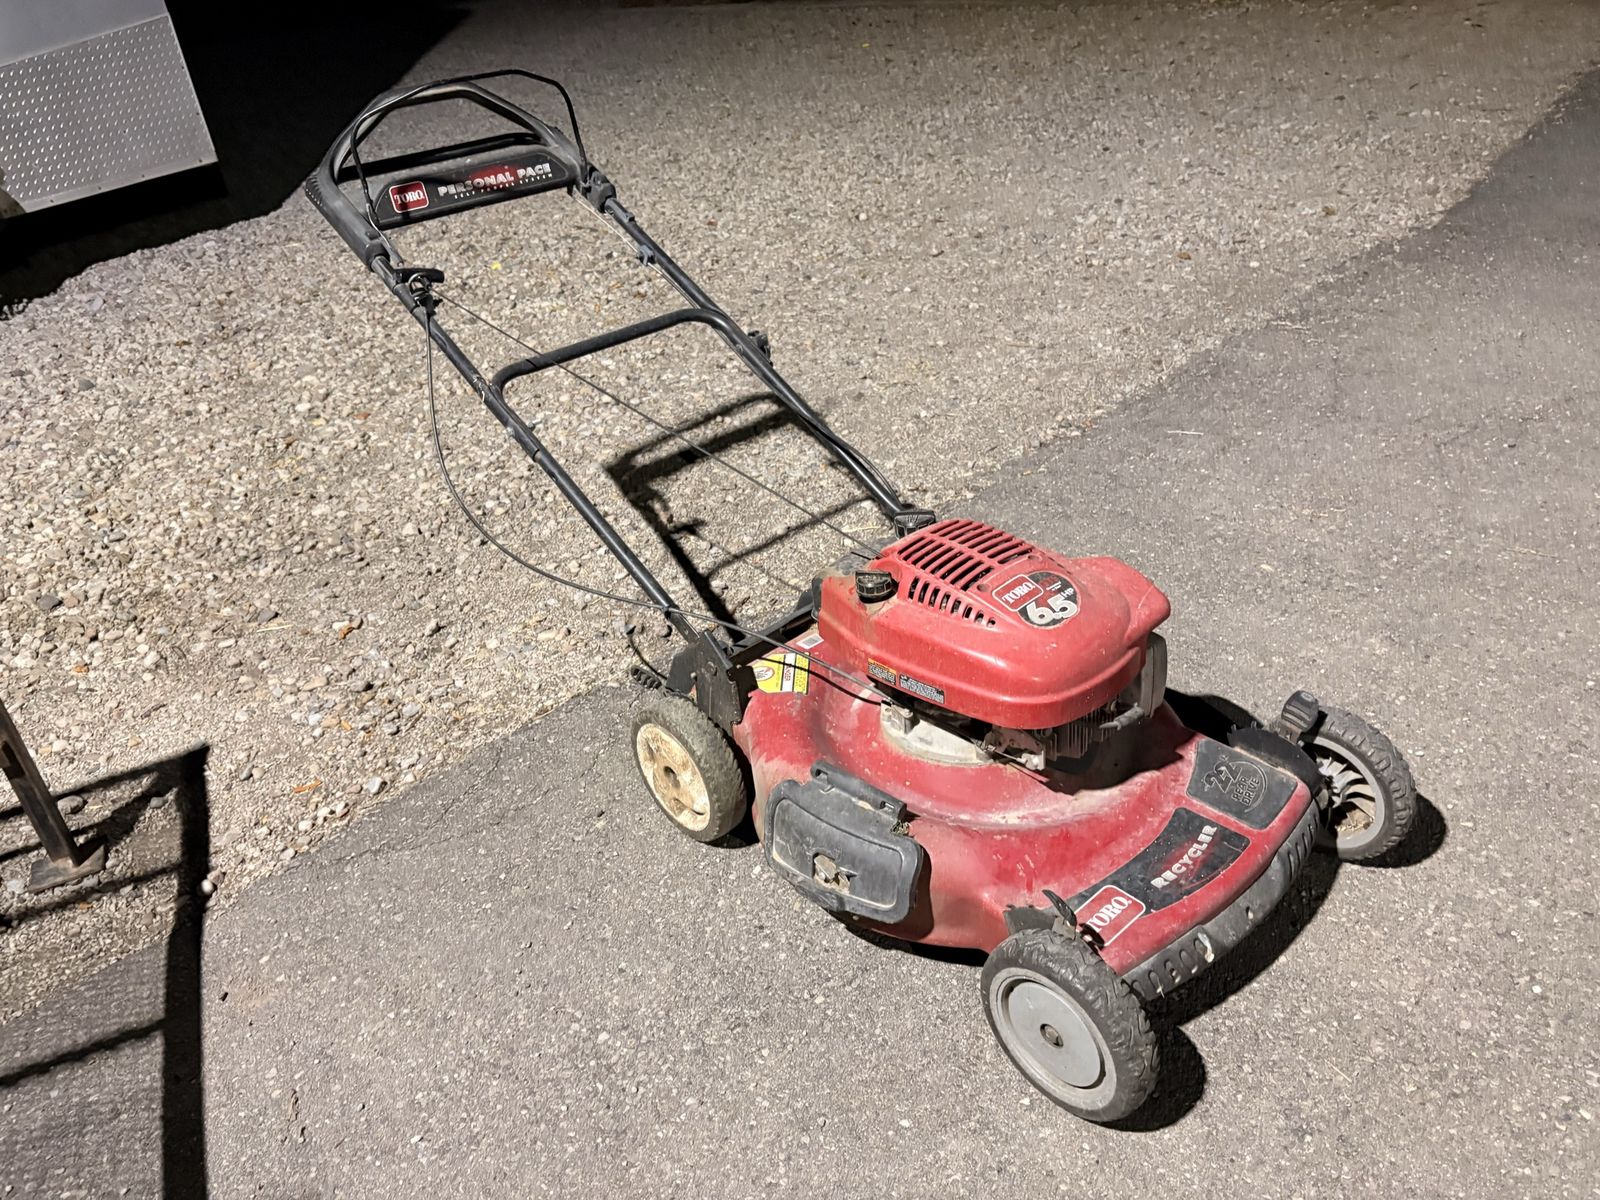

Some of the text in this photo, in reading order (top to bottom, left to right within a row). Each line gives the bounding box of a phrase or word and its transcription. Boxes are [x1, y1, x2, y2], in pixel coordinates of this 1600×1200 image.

[438, 163, 551, 196] PERSONAL PACE
[1231, 776, 1248, 801] REAR
[1240, 776, 1260, 806] DRIVE
[1151, 825, 1217, 888] RECYCLER
